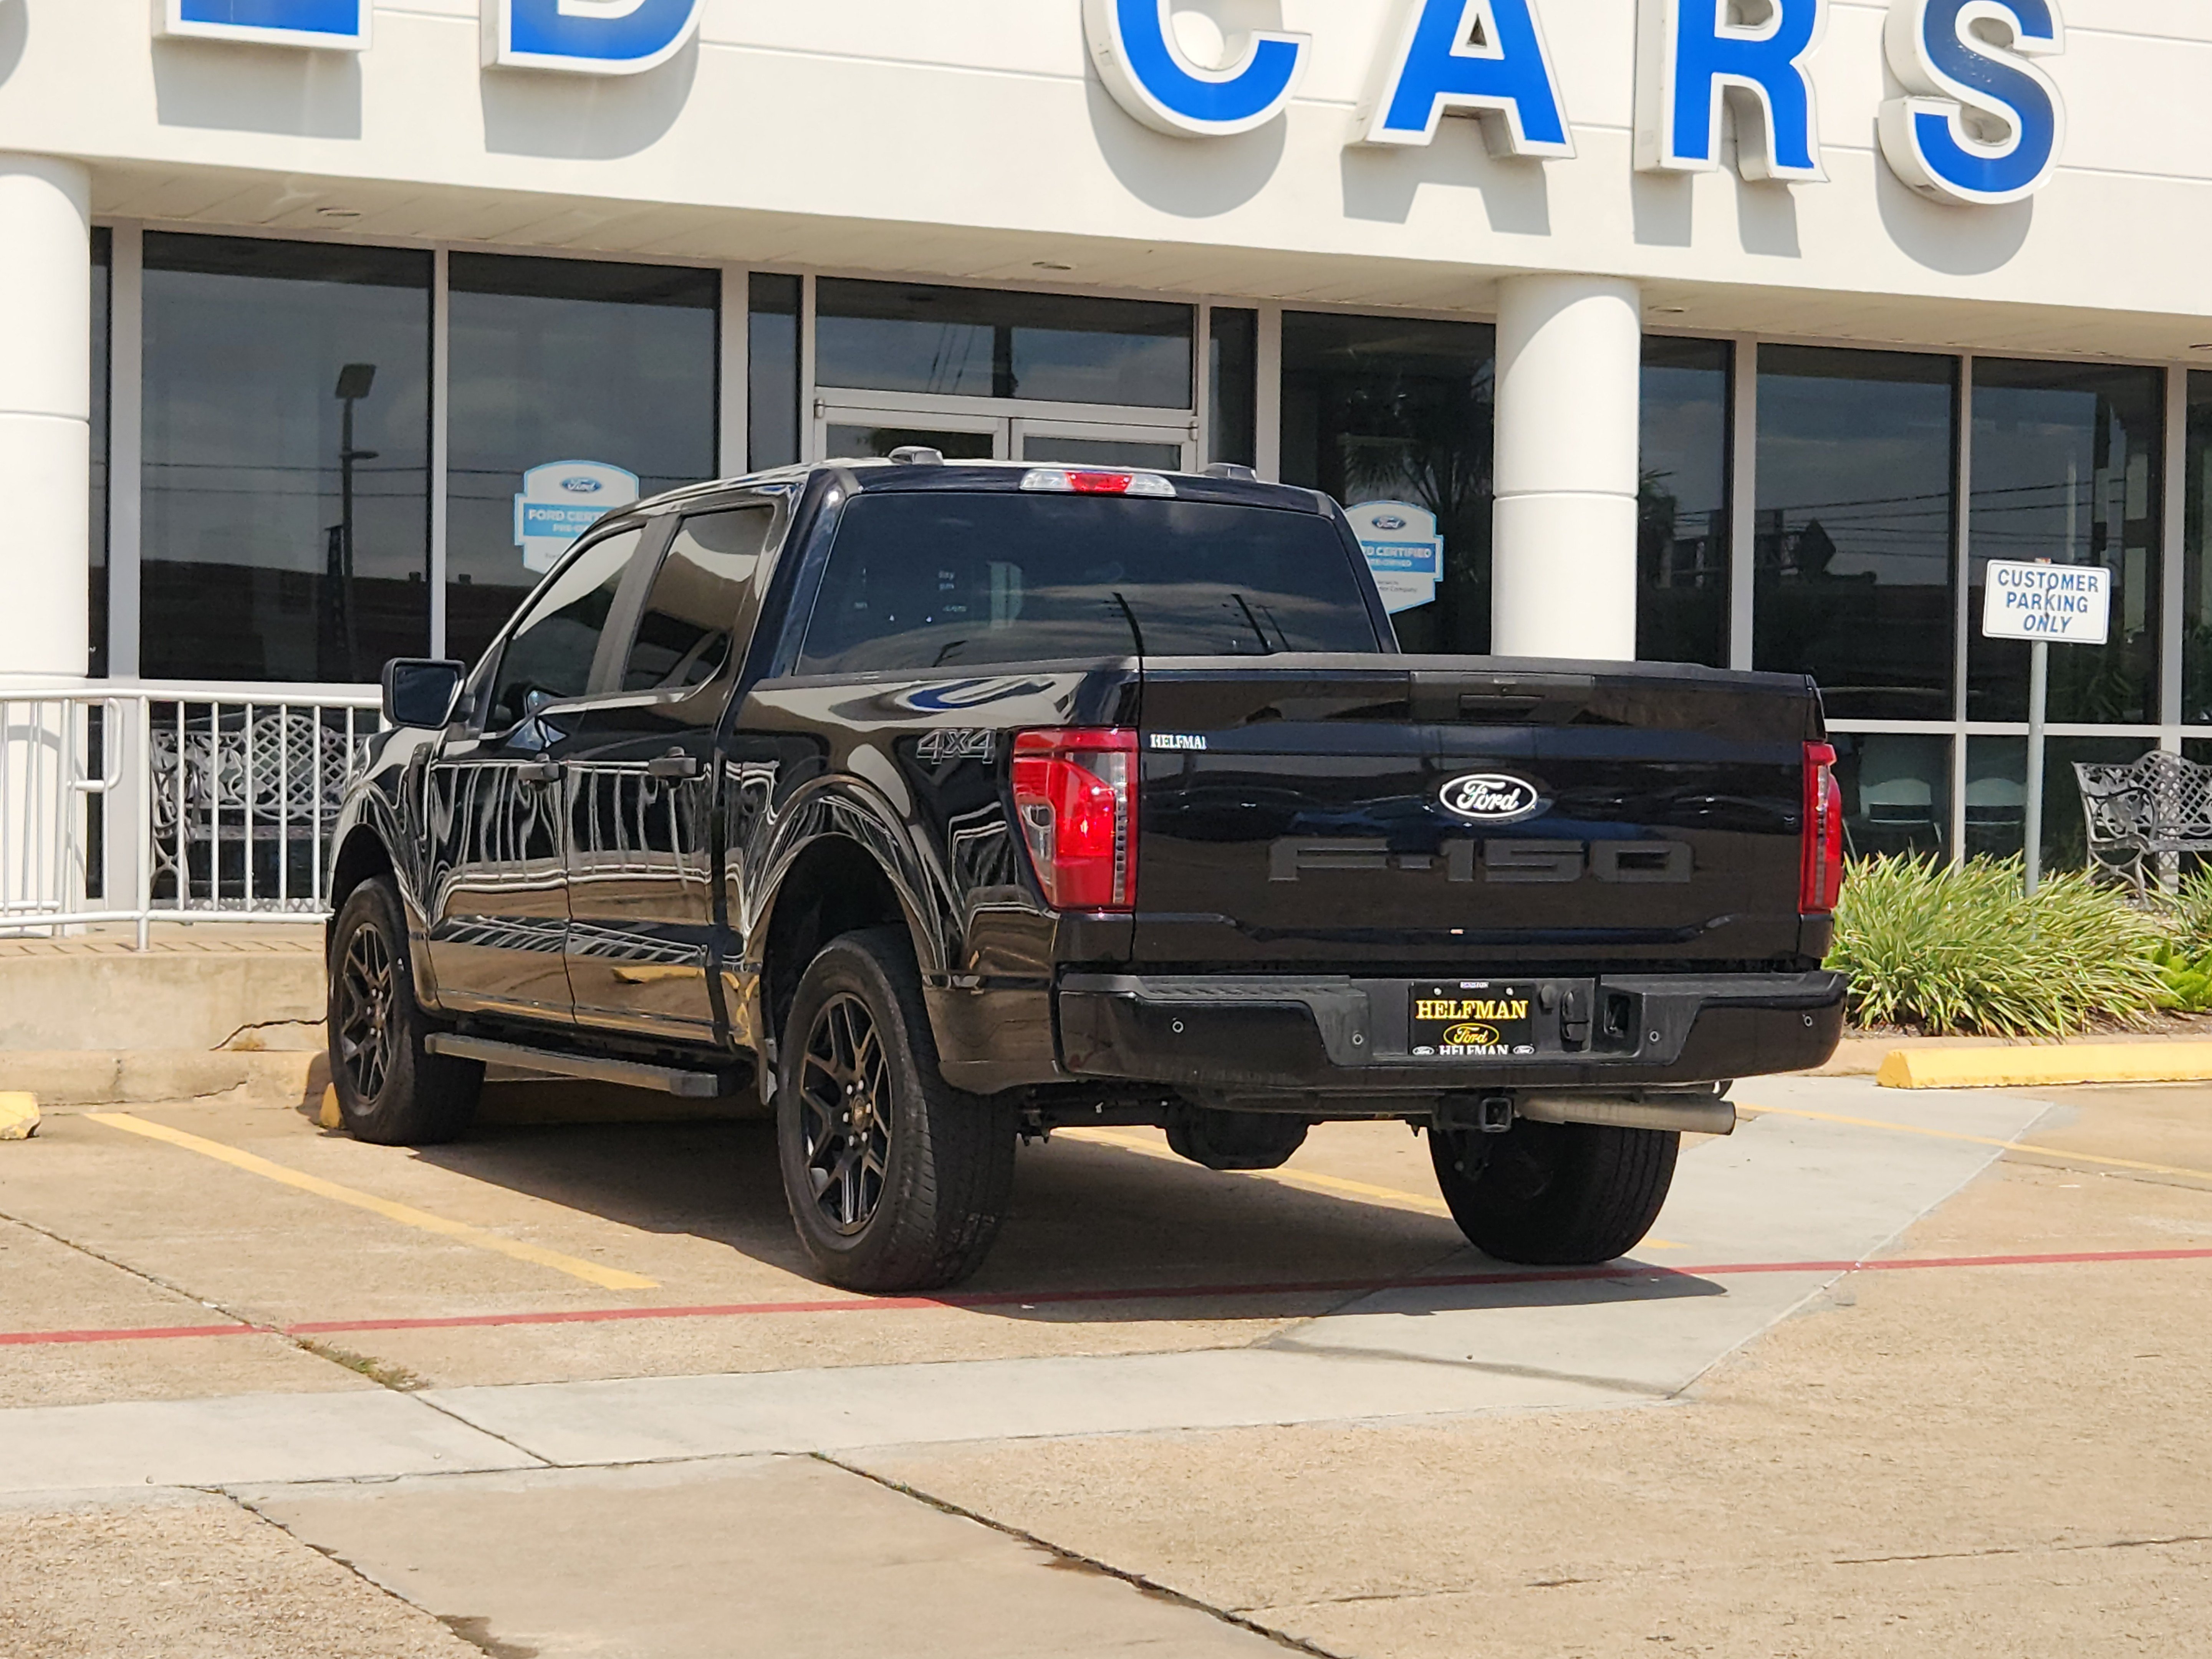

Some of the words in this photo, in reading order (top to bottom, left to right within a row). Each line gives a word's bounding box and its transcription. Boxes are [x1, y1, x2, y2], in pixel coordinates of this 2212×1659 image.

[1082, 0, 2066, 205] CARS
[528, 509, 565, 521] FORD
[1376, 546, 1432, 558] CERTIFIED
[1997, 568, 2099, 593] CUSTOMER
[2006, 591, 2088, 614] PARKING
[2023, 614, 2072, 633] ONLY
[1455, 780, 1521, 811] Ford
[1268, 836, 1694, 883] F-150
[1415, 1000, 1529, 1020] HELFMAN
[1453, 1026, 1489, 1044] Ford
